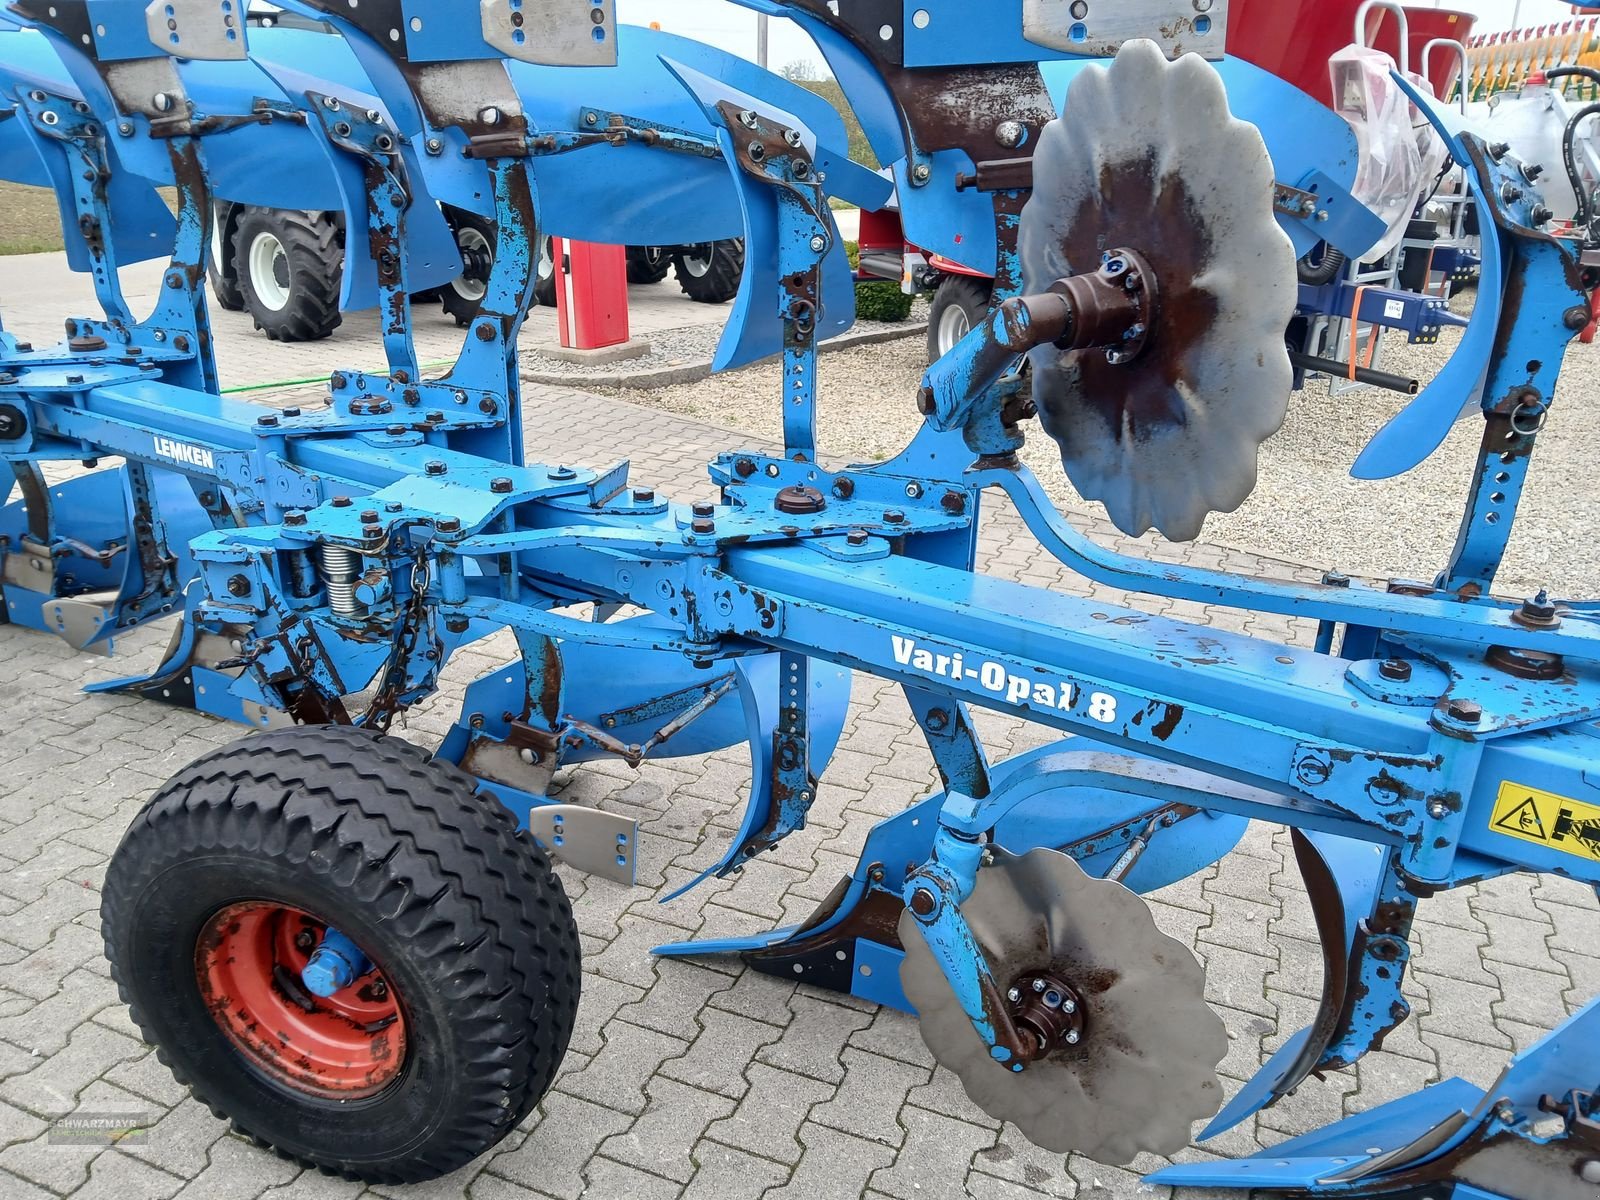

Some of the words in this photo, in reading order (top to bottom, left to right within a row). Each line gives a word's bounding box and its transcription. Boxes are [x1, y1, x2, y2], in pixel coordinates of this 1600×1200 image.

[153, 436, 214, 469] LEMKEN
[890, 635, 1073, 712] Vari-Opal
[1088, 691, 1118, 723] 8
